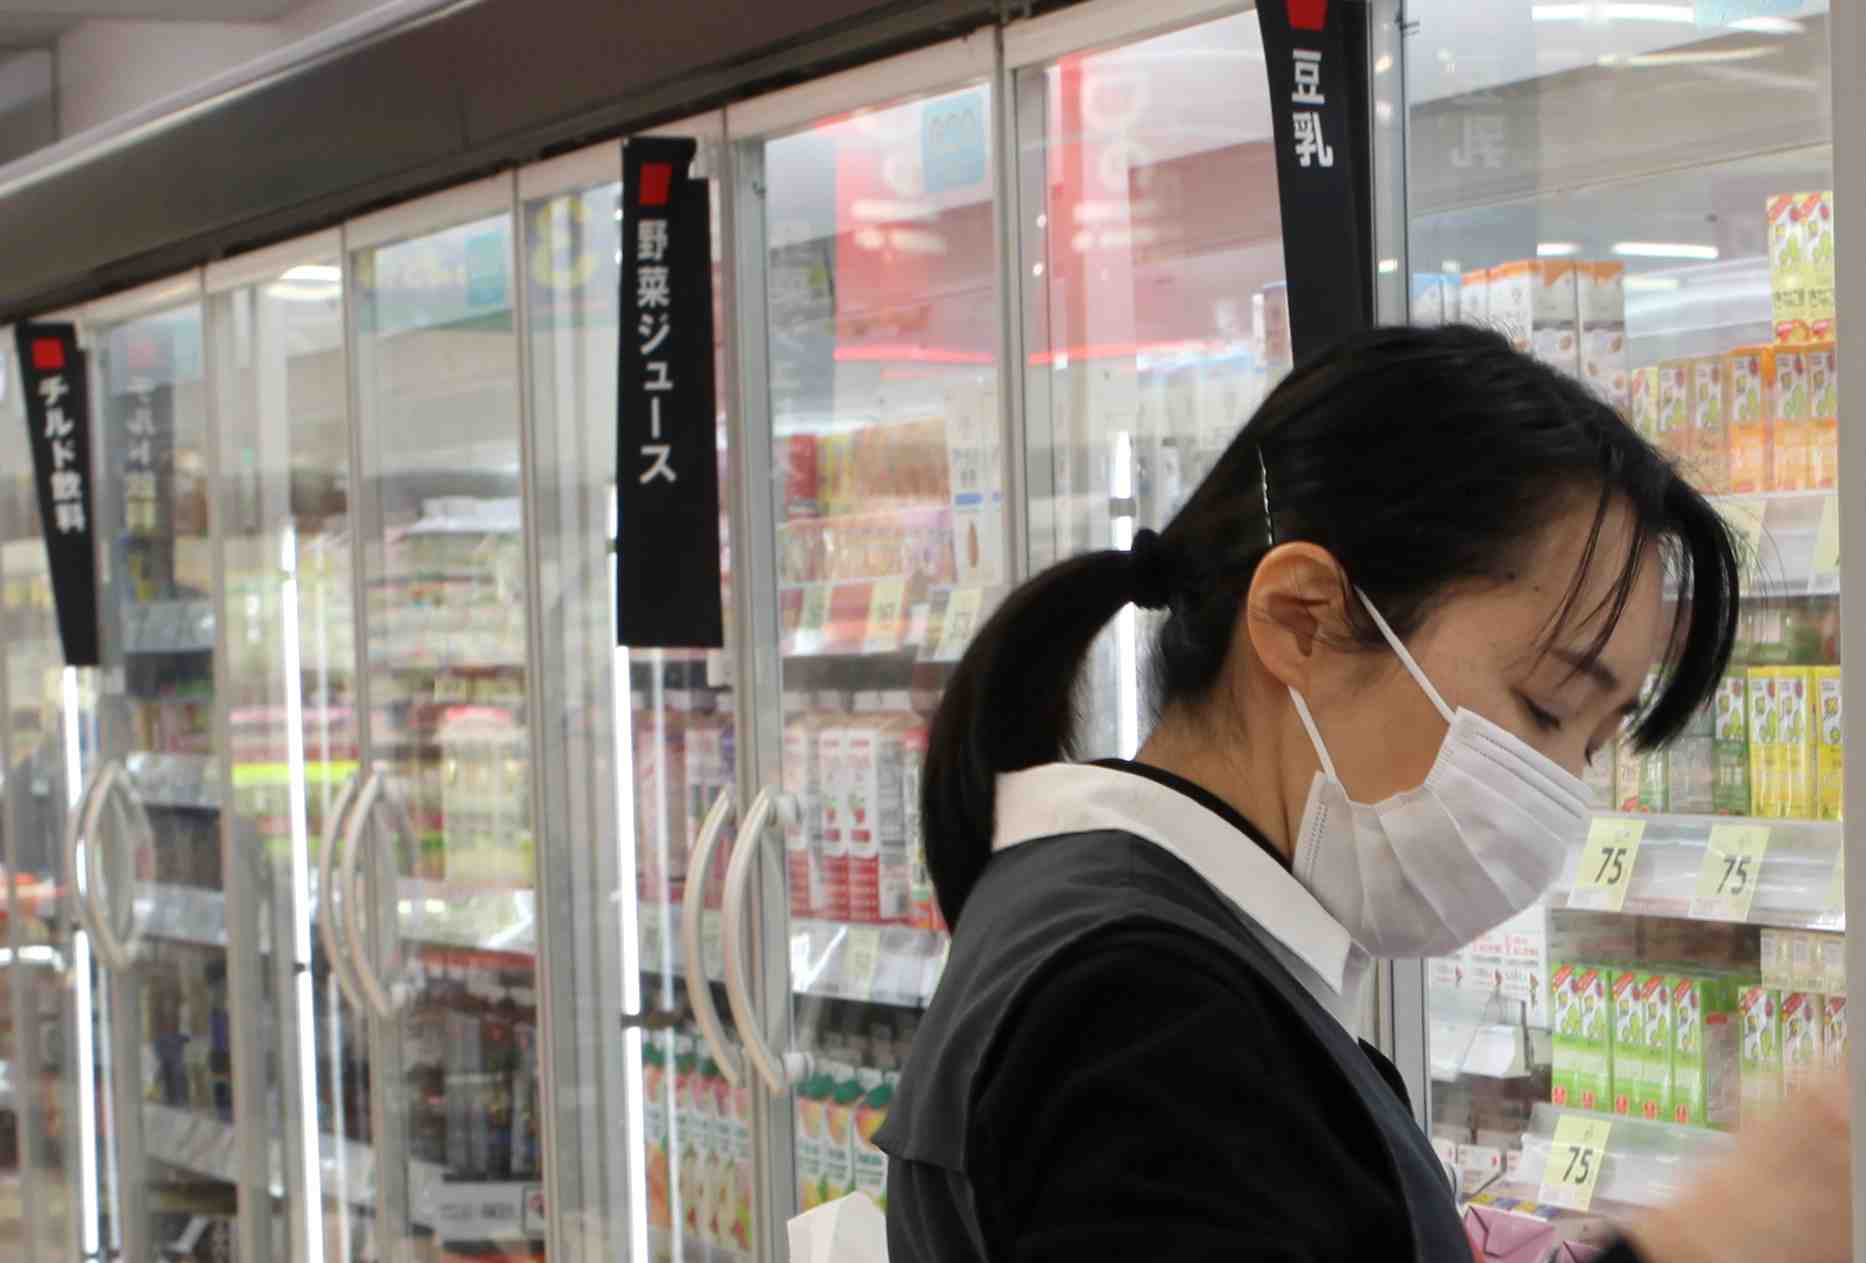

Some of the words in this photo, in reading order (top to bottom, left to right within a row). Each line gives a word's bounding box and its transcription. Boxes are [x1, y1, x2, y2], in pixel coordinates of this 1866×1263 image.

[1292, 49, 1333, 167] 豆乳
[638, 220, 677, 484] 野菜ジュース
[1595, 848, 1627, 885] 75
[1717, 855, 1750, 895] 75
[1561, 1148, 1593, 1185] 75
